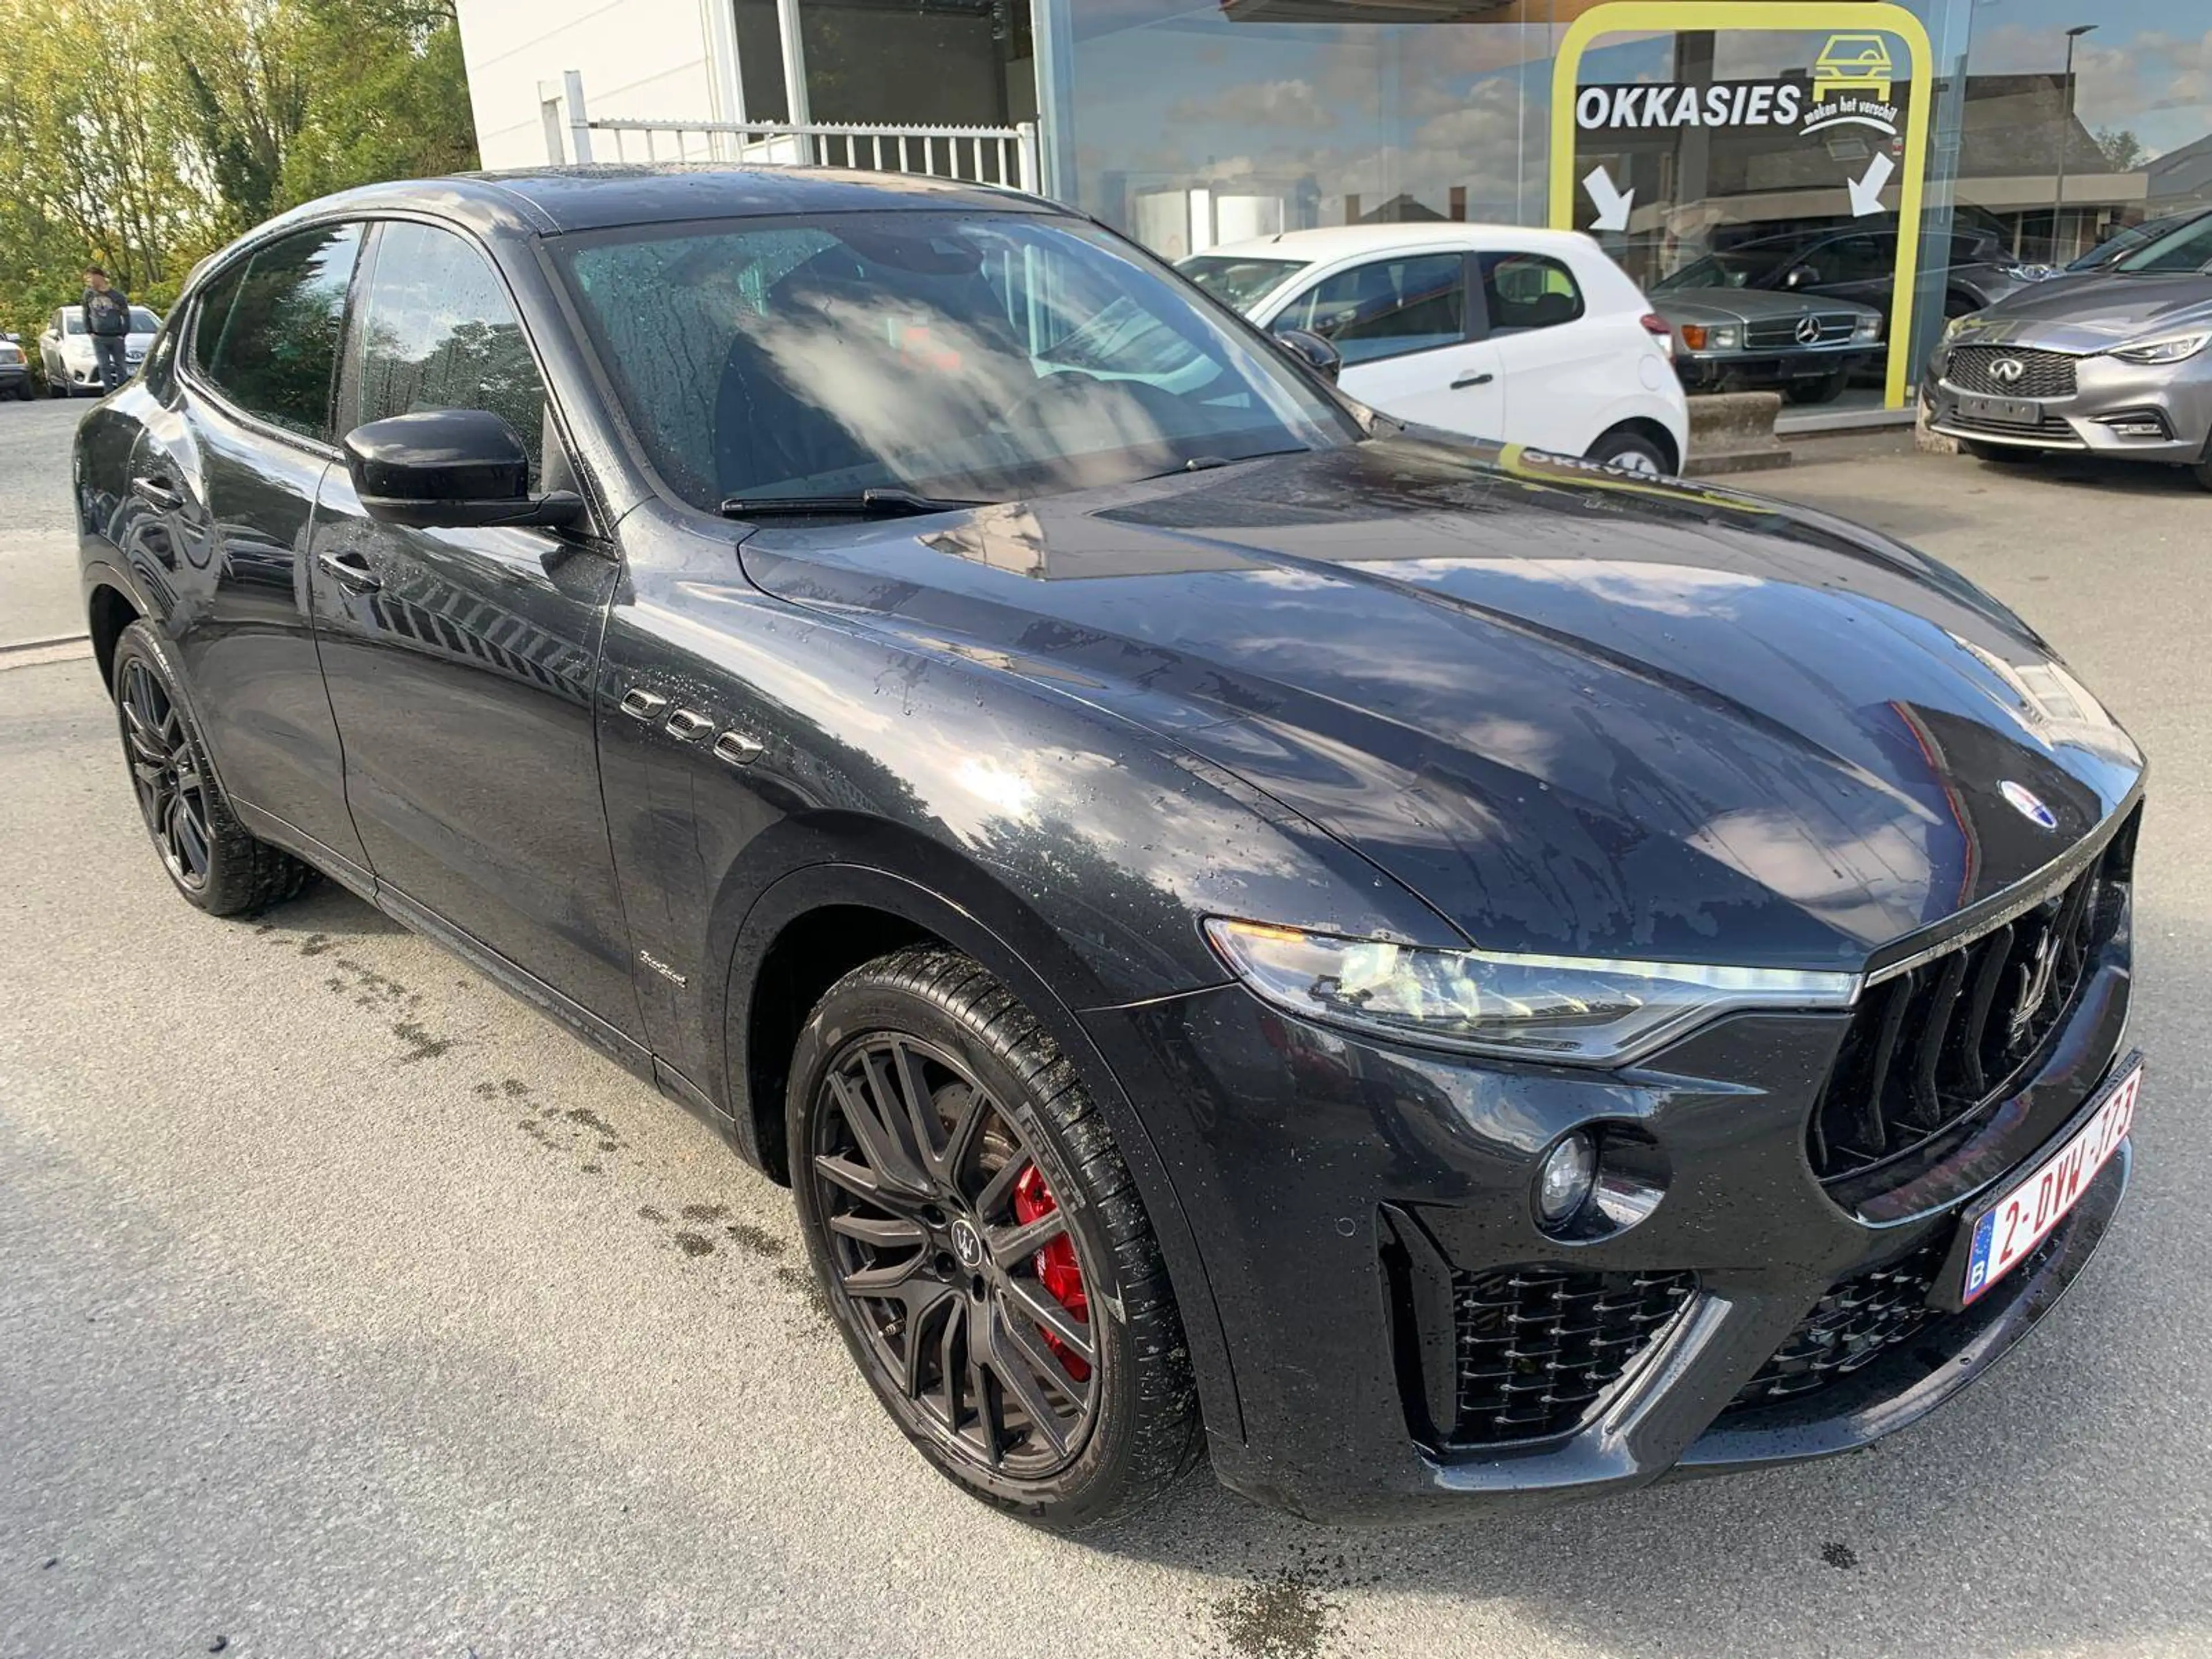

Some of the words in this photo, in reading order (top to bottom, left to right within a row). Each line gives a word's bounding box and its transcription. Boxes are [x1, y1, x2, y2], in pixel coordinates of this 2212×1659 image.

[1577, 85, 1801, 129] OKKASIES
[1840, 96, 1857, 112] het
[1859, 102, 1897, 123] verschil
[1970, 1260, 1985, 1290] B
